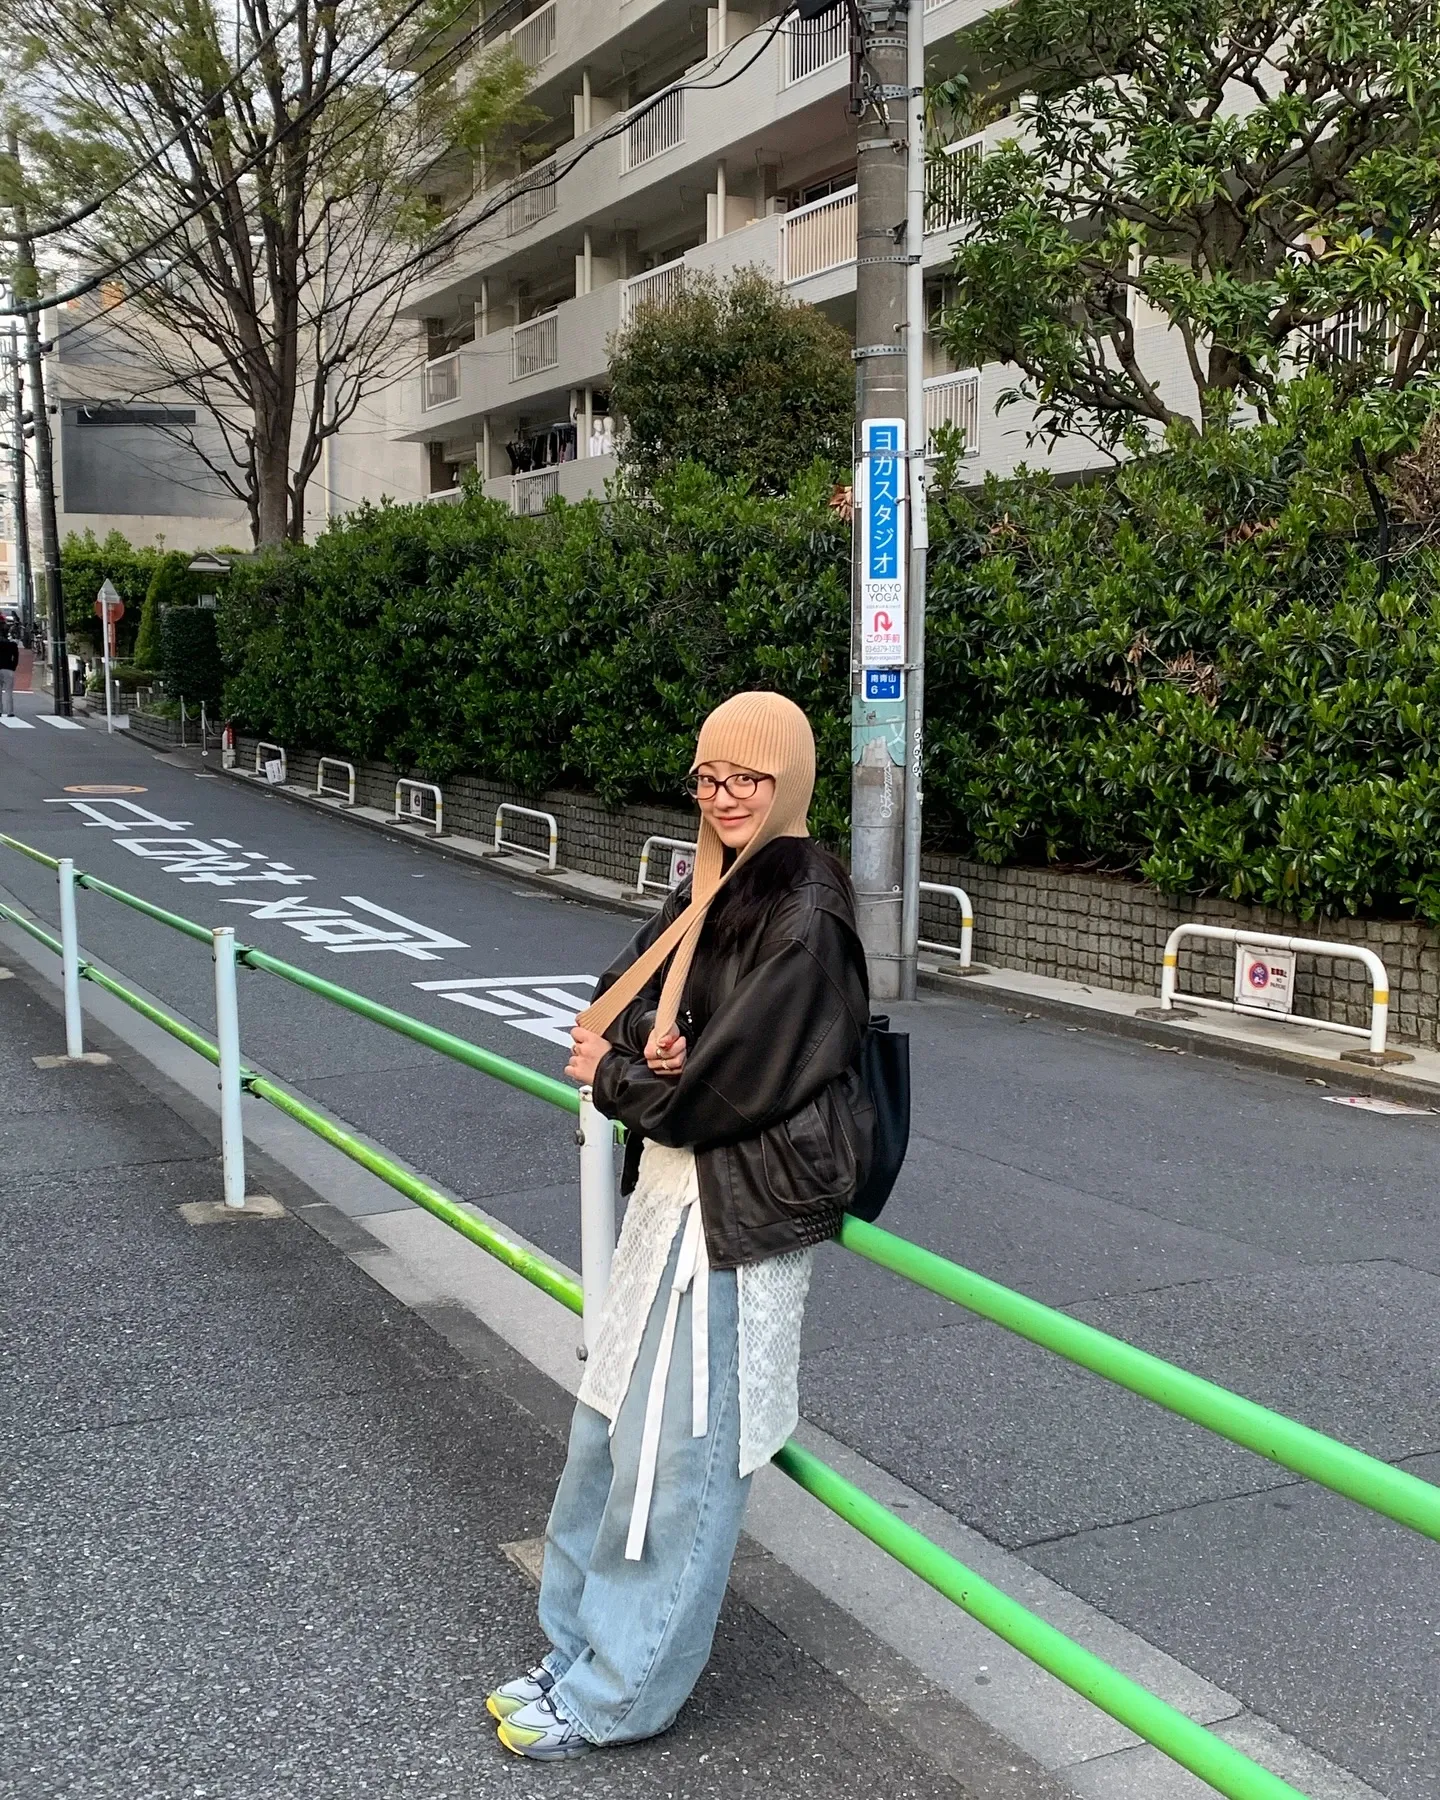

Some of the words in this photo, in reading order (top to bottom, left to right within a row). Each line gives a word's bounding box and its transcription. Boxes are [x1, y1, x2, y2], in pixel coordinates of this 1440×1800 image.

[874, 431, 893, 573] ヨガスタジオ
[866, 584, 901, 592] TOKYO
[870, 593, 899, 601] YOGA
[866, 634, 901, 643] この手前
[870, 674, 897, 683] 南青山
